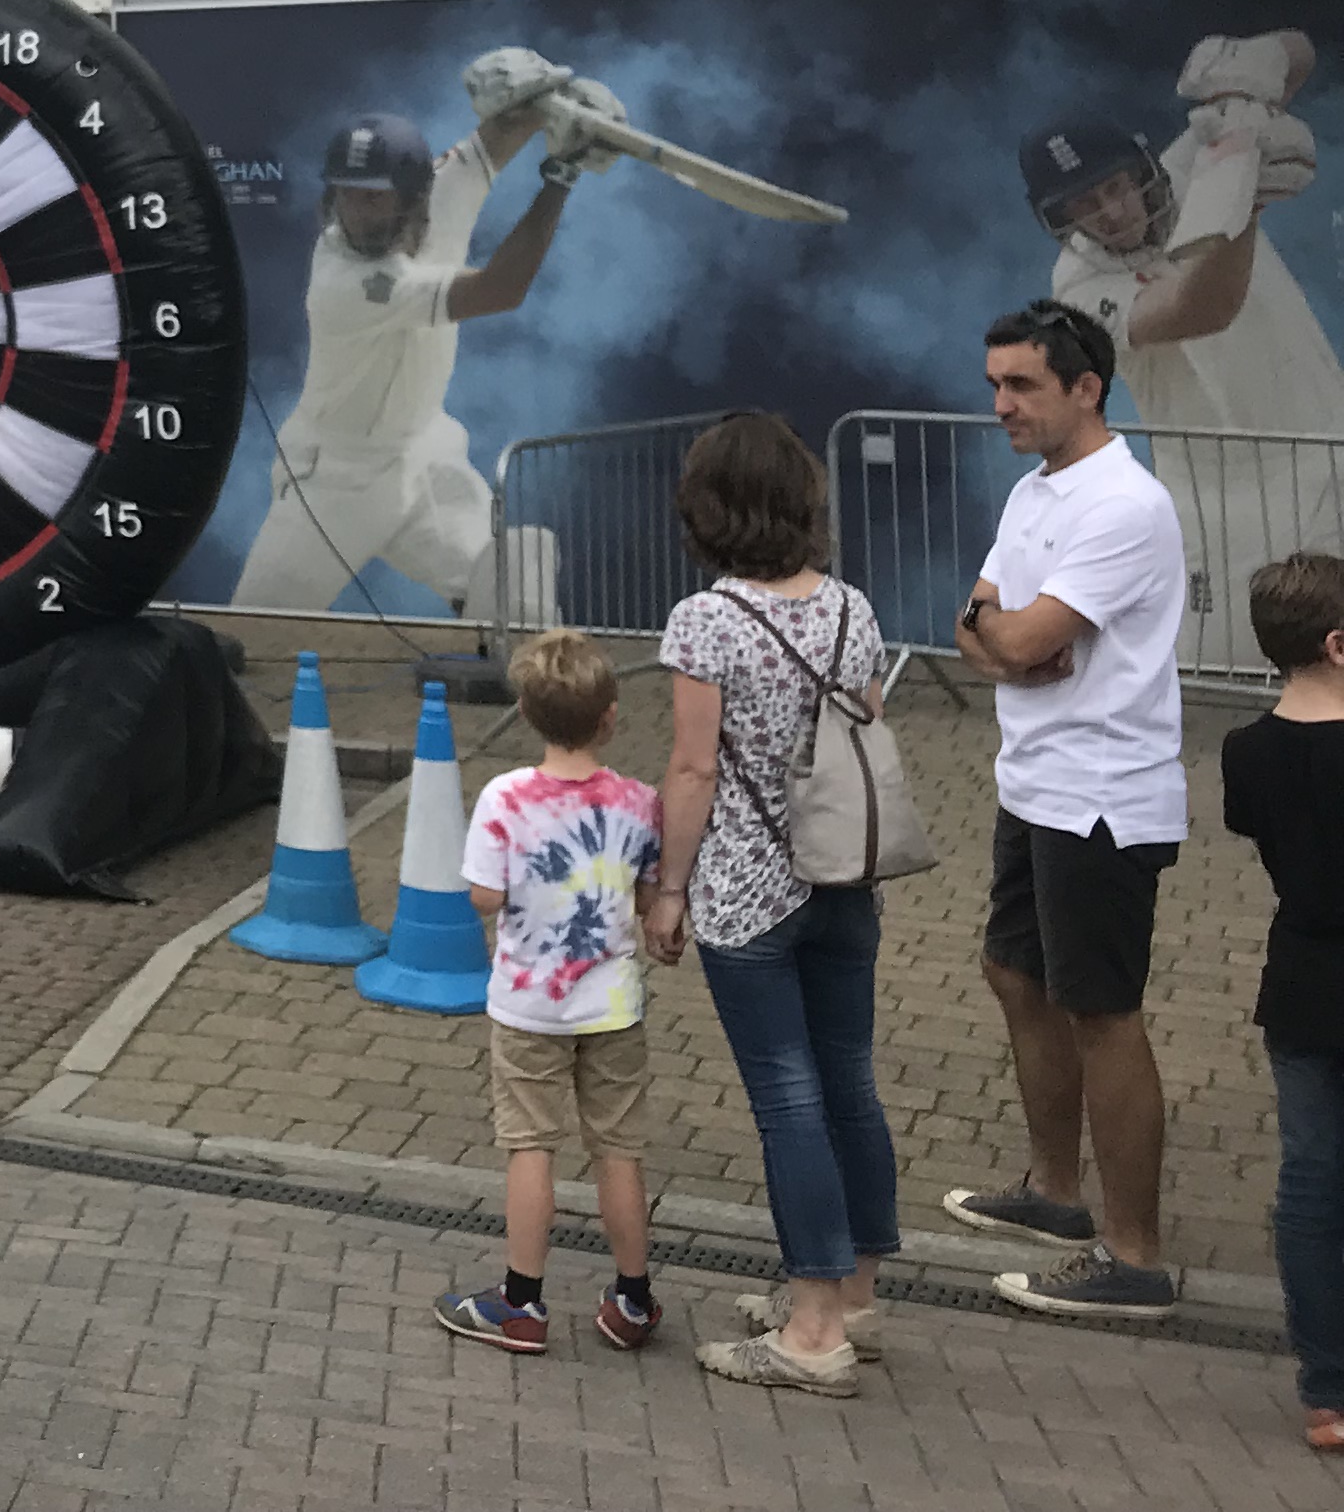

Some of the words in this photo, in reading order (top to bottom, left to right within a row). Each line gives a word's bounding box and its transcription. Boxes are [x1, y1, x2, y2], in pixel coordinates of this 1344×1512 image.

[79, 103, 104, 135] 4
[121, 195, 167, 229] 13
[156, 303, 180, 337] 6
[135, 406, 181, 440] 10
[95, 502, 143, 538] 15
[39, 580, 64, 612] 2
